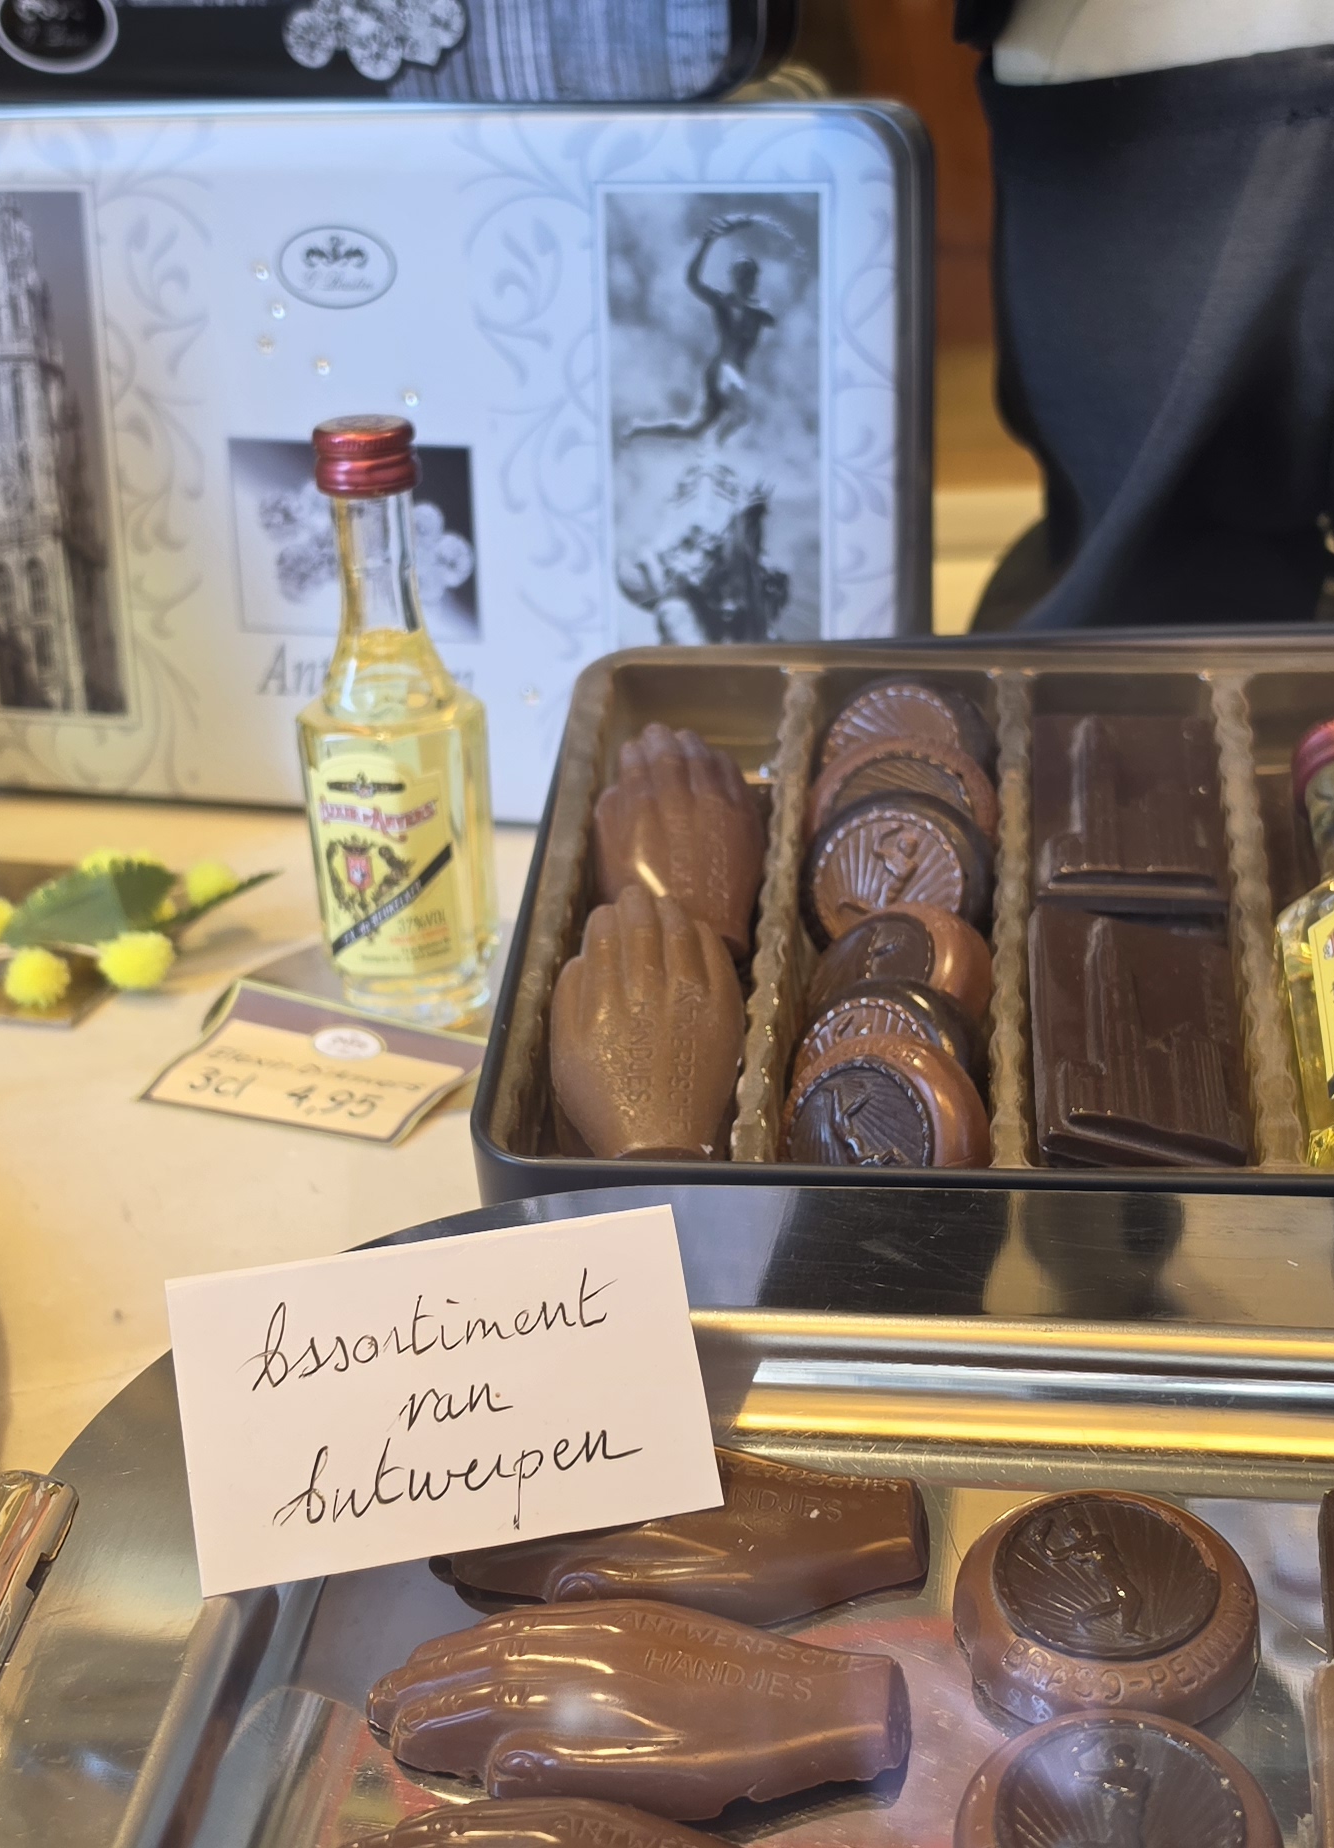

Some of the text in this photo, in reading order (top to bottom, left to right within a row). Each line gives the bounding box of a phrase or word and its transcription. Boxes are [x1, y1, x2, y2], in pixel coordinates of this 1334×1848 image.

[284, 1082, 384, 1119] 4,95
[236, 1266, 618, 1392] Assortiment
[387, 1380, 513, 1432] van
[272, 1426, 643, 1531] Antwerpen
[731, 1486, 843, 1523] NDJES
[642, 1648, 814, 1702] HANDJES
